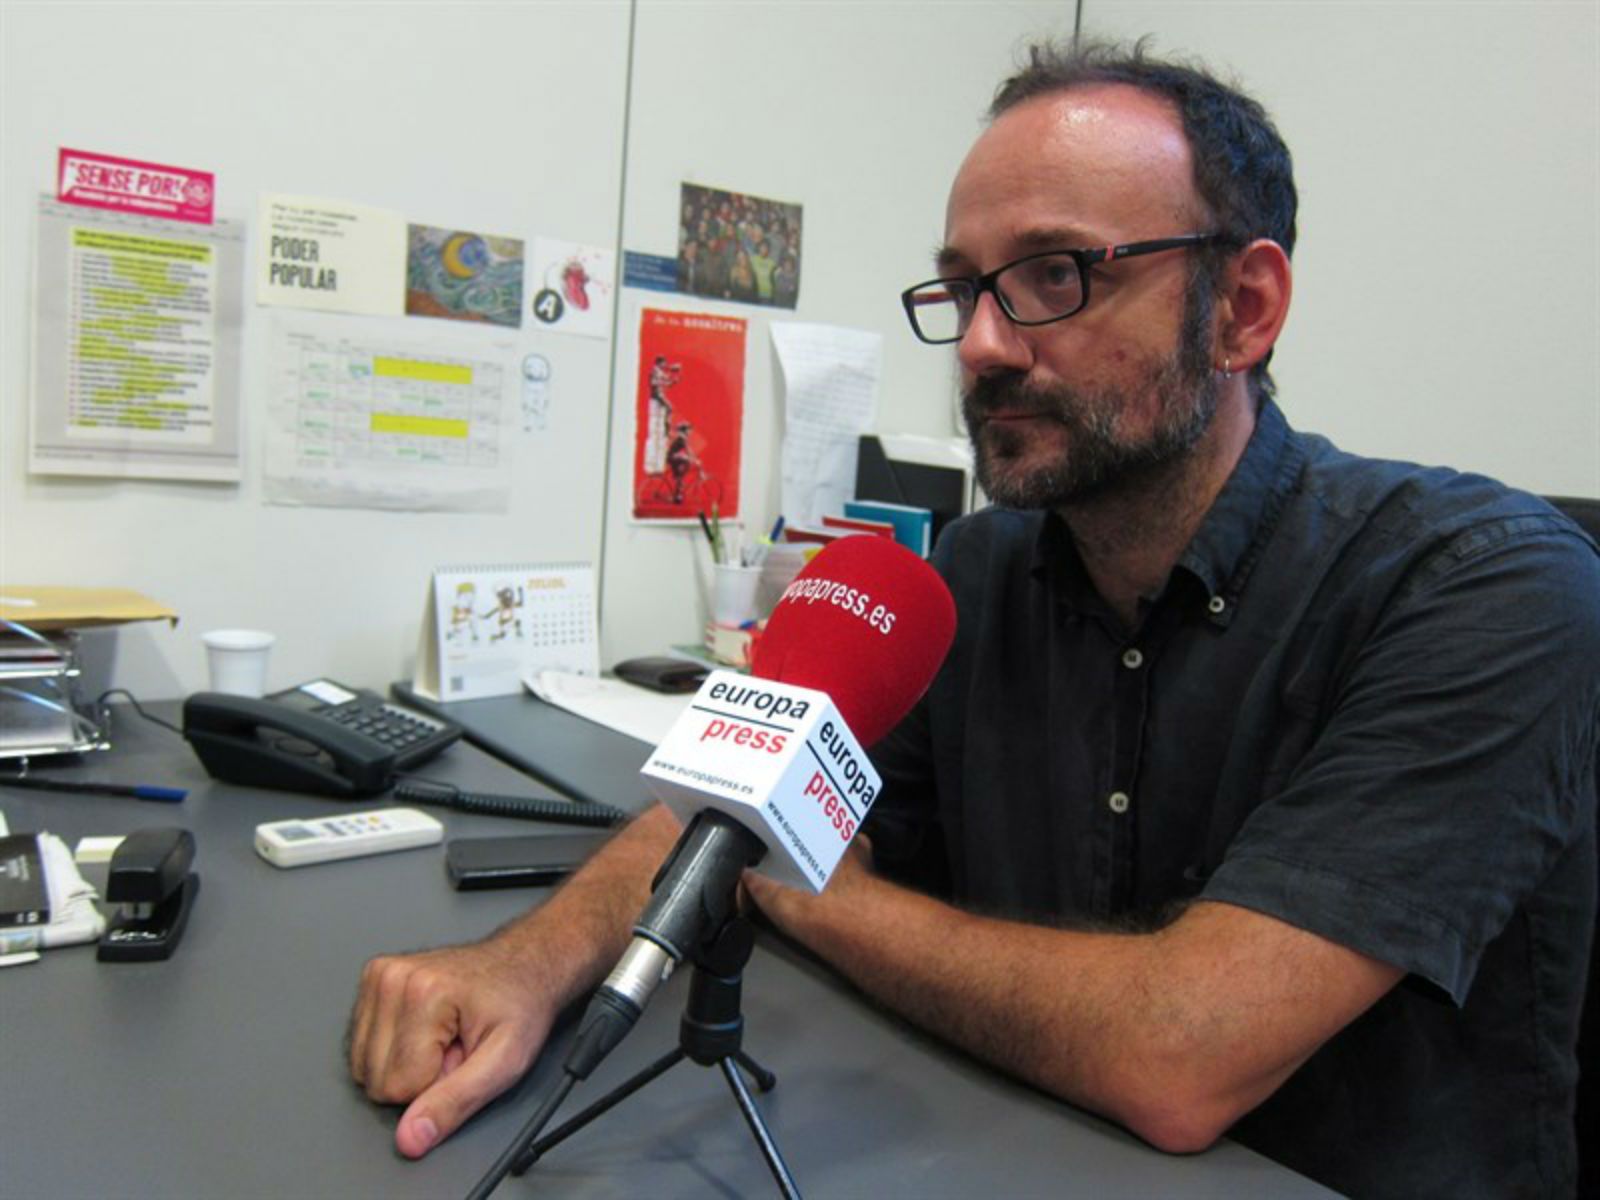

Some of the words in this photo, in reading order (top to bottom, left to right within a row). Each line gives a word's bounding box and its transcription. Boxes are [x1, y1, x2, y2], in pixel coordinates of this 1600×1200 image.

[271, 235, 320, 262] PODER
[270, 262, 337, 291] POPULAR
[709, 681, 812, 720] europa
[700, 718, 787, 754] press
[652, 759, 755, 795] www.europapress.es
[819, 721, 875, 808] europa
[803, 770, 856, 842] press
[767, 801, 827, 882] www.europapress.es
